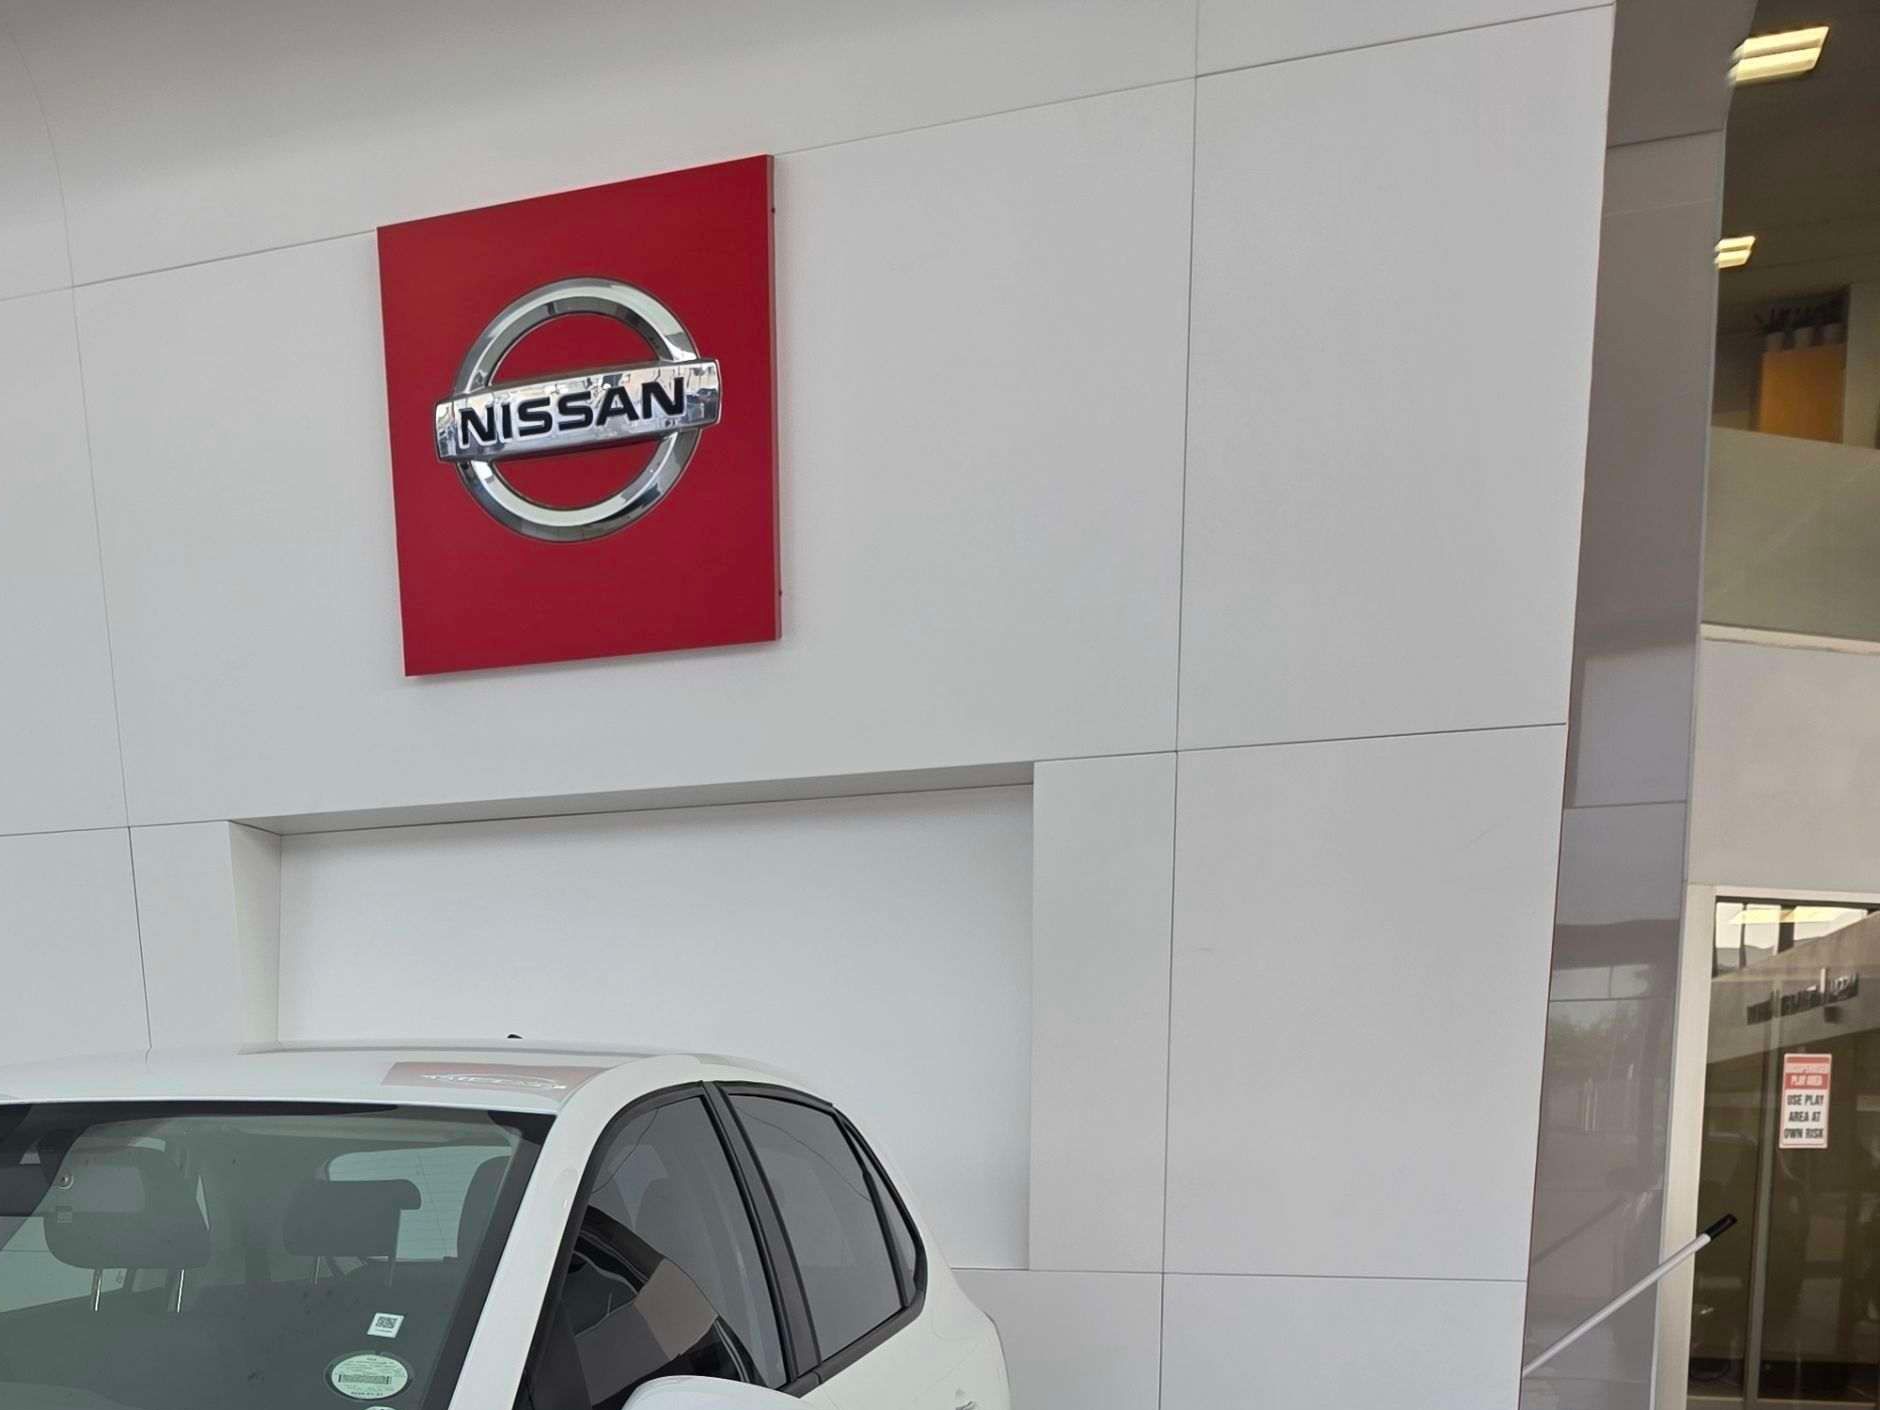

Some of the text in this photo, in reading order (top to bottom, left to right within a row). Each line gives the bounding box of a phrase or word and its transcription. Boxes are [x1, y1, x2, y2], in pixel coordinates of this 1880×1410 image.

[458, 375, 687, 447] NISSAN
[1787, 1094, 1824, 1105] USE PLAY
[1788, 1111, 1821, 1122] AREA AT
[1783, 1128, 1824, 1139] OWN RISK
